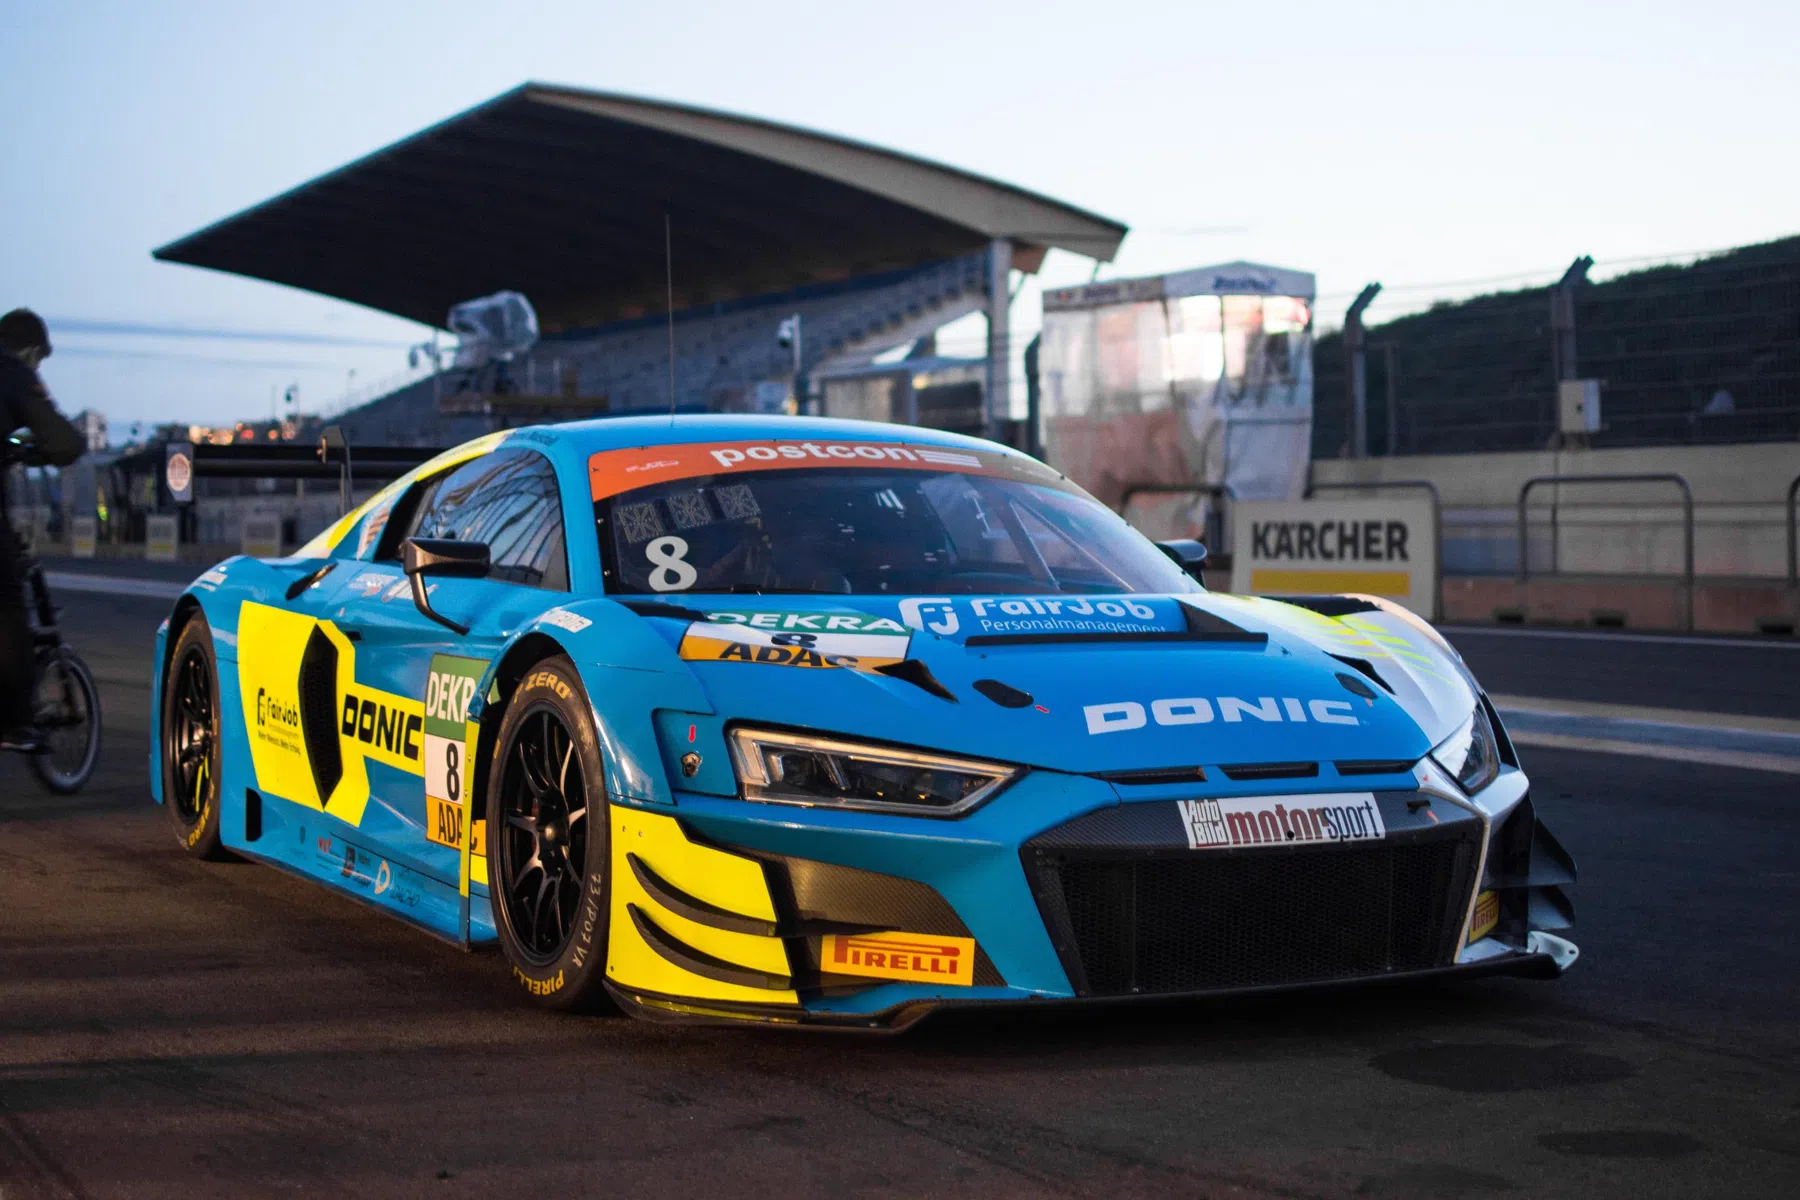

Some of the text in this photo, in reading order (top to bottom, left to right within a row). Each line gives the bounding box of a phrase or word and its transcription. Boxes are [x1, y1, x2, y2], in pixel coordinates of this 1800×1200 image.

[710, 443, 918, 467] postcon
[1252, 520, 1409, 561] KÄRCHER
[645, 536, 698, 592] 8
[970, 598, 1155, 620] FairJob
[426, 671, 491, 723] DEKR
[525, 671, 571, 700] ZERO
[342, 694, 423, 761] DONIC
[1083, 697, 1360, 735] DONIC
[446, 743, 461, 802] 8
[1187, 799, 1220, 823] Auto
[1192, 820, 1229, 844] Bild
[834, 934, 961, 975] PIRELLI
[512, 966, 565, 996] PIRELLI
